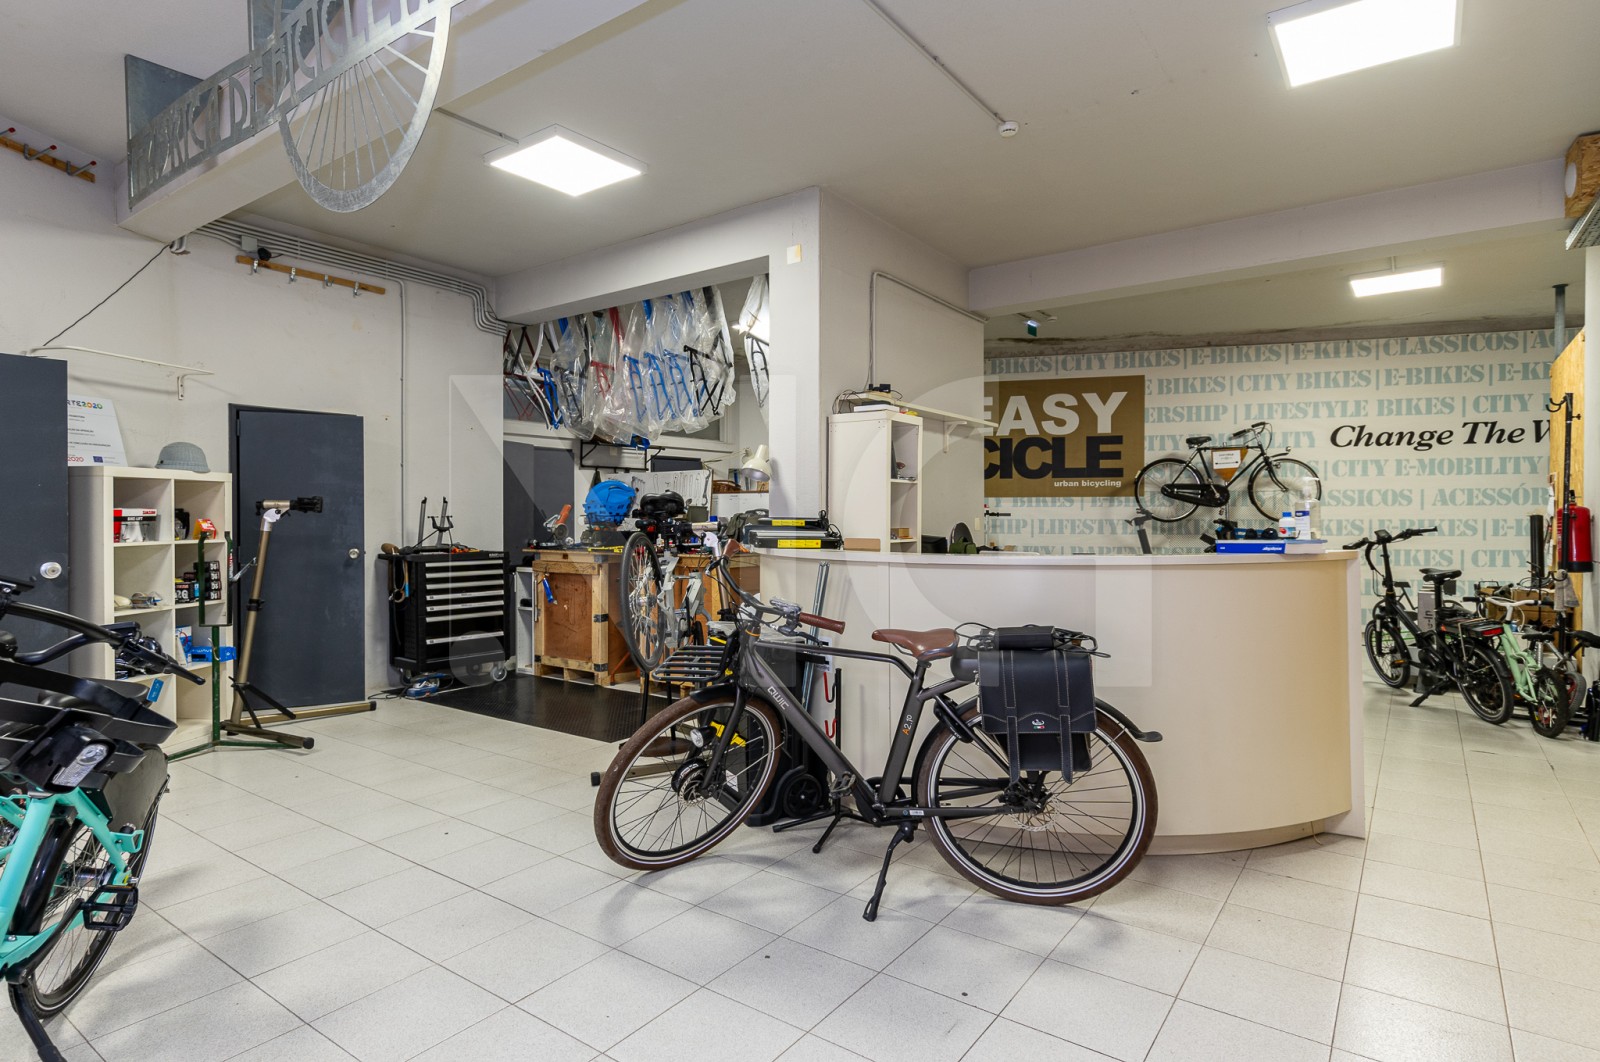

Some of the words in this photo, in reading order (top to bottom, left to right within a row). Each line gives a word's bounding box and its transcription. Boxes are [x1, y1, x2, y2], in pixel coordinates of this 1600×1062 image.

[990, 356, 1052, 375] BIKES
[1060, 353, 1109, 372] CITY
[1113, 349, 1181, 368] BIKES
[1191, 345, 1282, 366] E-BIKES
[1293, 340, 1372, 360] E-KITS
[1383, 332, 1519, 356] CLASSICOS
[1157, 376, 1226, 395] BIKES
[1237, 373, 1292, 392] CITY
[1296, 369, 1372, 390] BIKES
[1384, 364, 1485, 386] E-BIKES
[1244, 400, 1368, 420] LIFESTYLE
[1376, 396, 1455, 417] BIKES
[1472, 393, 1534, 414] CITY
[1330, 424, 1454, 452] Change
[1461, 420, 1526, 445] The
[1331, 458, 1388, 478] CITY
[1394, 455, 1543, 477] E-MOBILITY
[1053, 480, 1080, 488] urban
[1081, 479, 1122, 489] bicycling
[1470, 548, 1531, 568] CITY
[767, 685, 790, 710] QWIC
